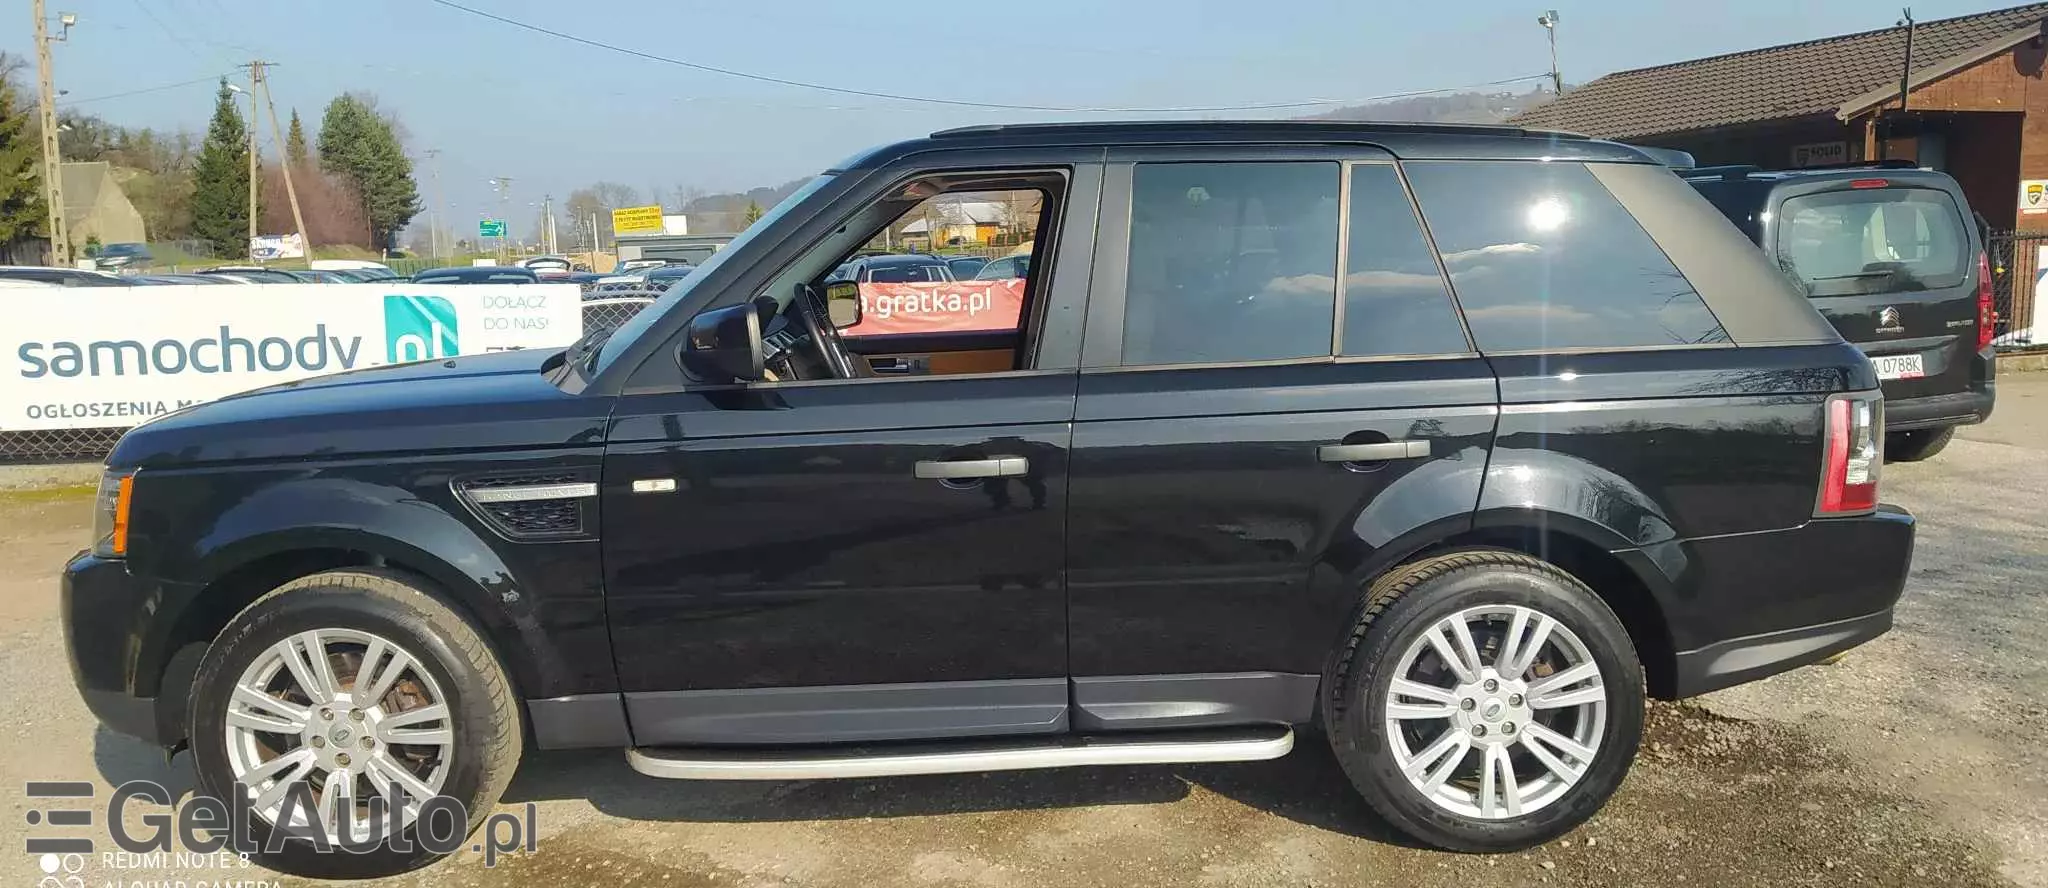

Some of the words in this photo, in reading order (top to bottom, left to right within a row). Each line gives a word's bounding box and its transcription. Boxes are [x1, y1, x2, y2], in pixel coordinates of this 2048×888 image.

[482, 295, 547, 311] DOŁĄCZ
[483, 317, 508, 330] DO
[514, 317, 550, 330] NAS!
[1883, 356, 1920, 373] 0788K
[26, 400, 168, 419] OGŁOSZENIA
